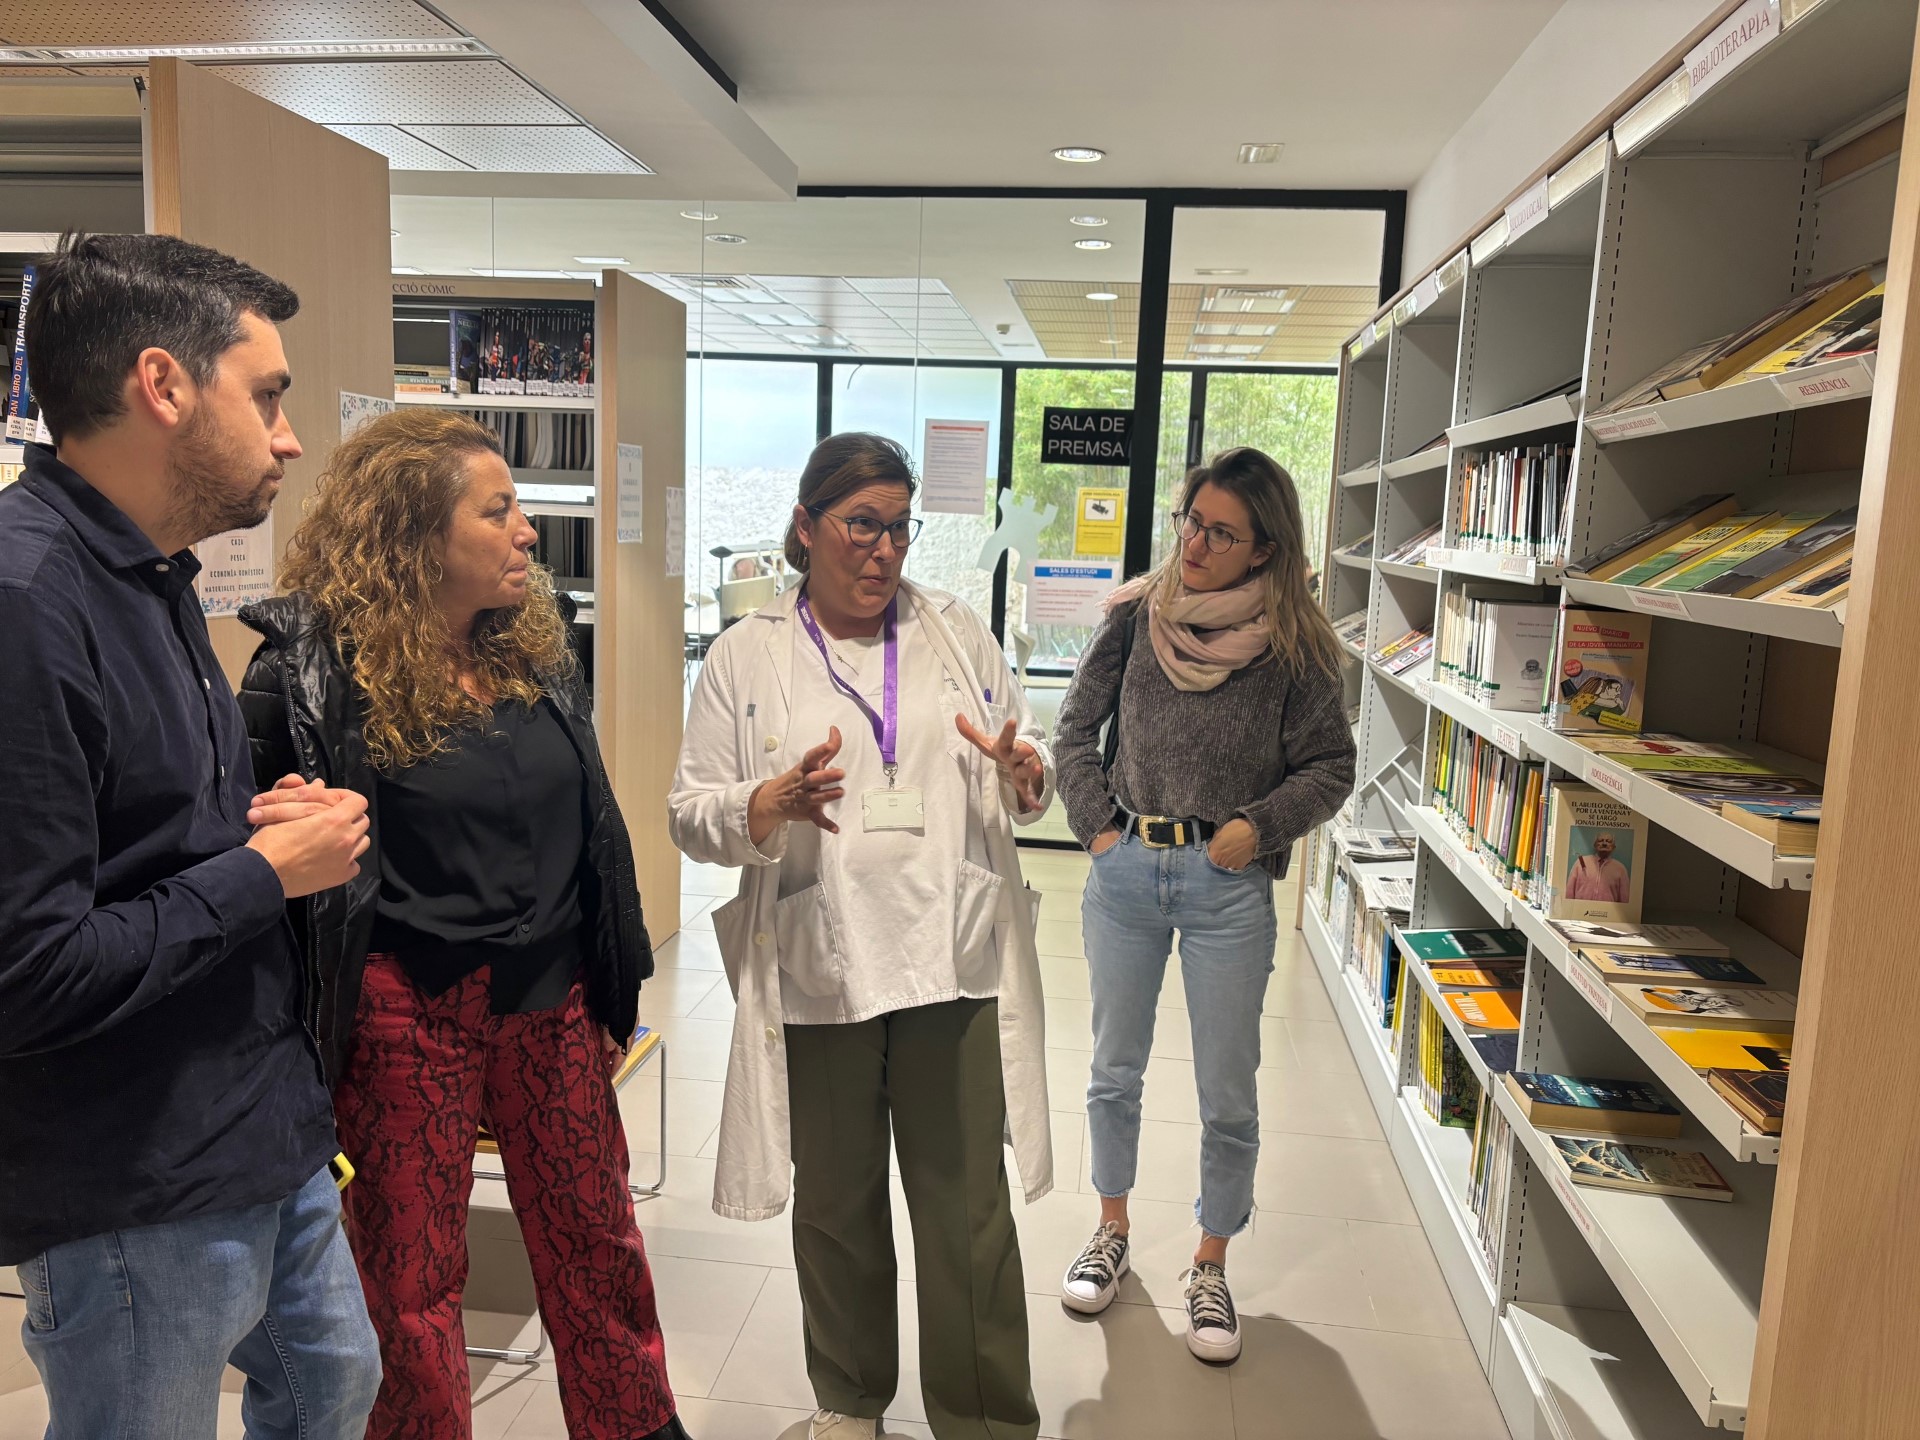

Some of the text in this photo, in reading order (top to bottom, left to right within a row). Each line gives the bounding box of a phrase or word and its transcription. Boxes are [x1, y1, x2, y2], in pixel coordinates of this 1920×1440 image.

[1692, 8, 1770, 87] BIBLIOTERAPIA
[420, 282, 456, 294] CÒMIC
[15, 273, 33, 353] TRANSPORTE
[15, 356, 24, 372] DEL
[12, 374, 21, 396] LIBRO
[1798, 377, 1850, 396] RESILIÈNCIA
[1049, 414, 1125, 433] SALA DE
[1047, 439, 1125, 457] PREMSA
[210, 569, 237, 578] ECONOMÍA
[204, 585, 236, 593] MATERIALES
[1602, 628, 1623, 637] DIARIO
[1496, 727, 1517, 752] TEATRE
[1591, 767, 1623, 793] ADOLESCÈNCIA
[1596, 820, 1630, 828] JONASSON
